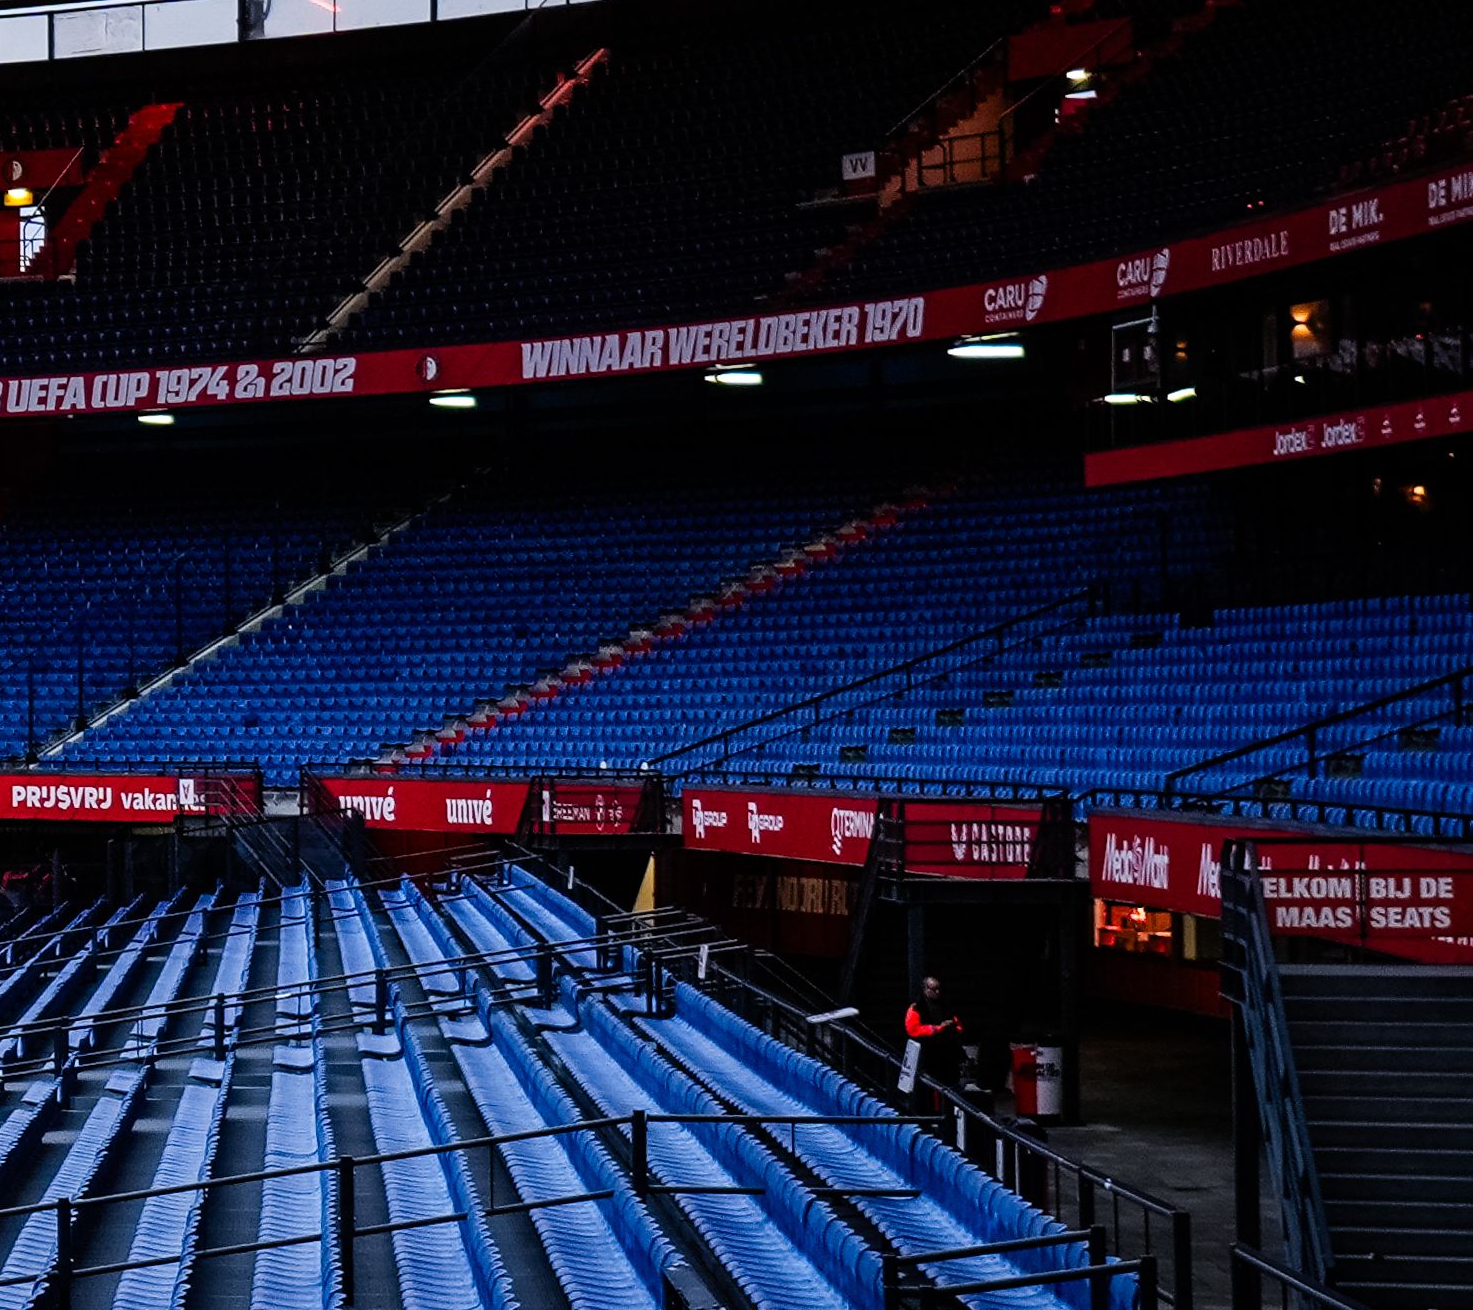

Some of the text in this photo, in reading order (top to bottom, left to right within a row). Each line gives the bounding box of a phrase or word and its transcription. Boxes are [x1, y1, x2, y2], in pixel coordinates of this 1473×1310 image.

[1211, 230, 1289, 272] RIVERDALE
[1117, 257, 1151, 287] CARU
[984, 283, 1025, 312] CARU
[521, 297, 926, 378] WINNAAR WERELDBEKER 1970
[5, 377, 85, 412] UEFA
[90, 375, 151, 407] CUP
[156, 366, 231, 402] 1974
[234, 364, 266, 397] &
[269, 357, 358, 395] 2002
[120, 787, 206, 811] vakanes
[445, 789, 493, 825] univé
[1259, 876, 1456, 900] ELKOM BIJ DE
[1275, 906, 1454, 930] MAAS SEATS
